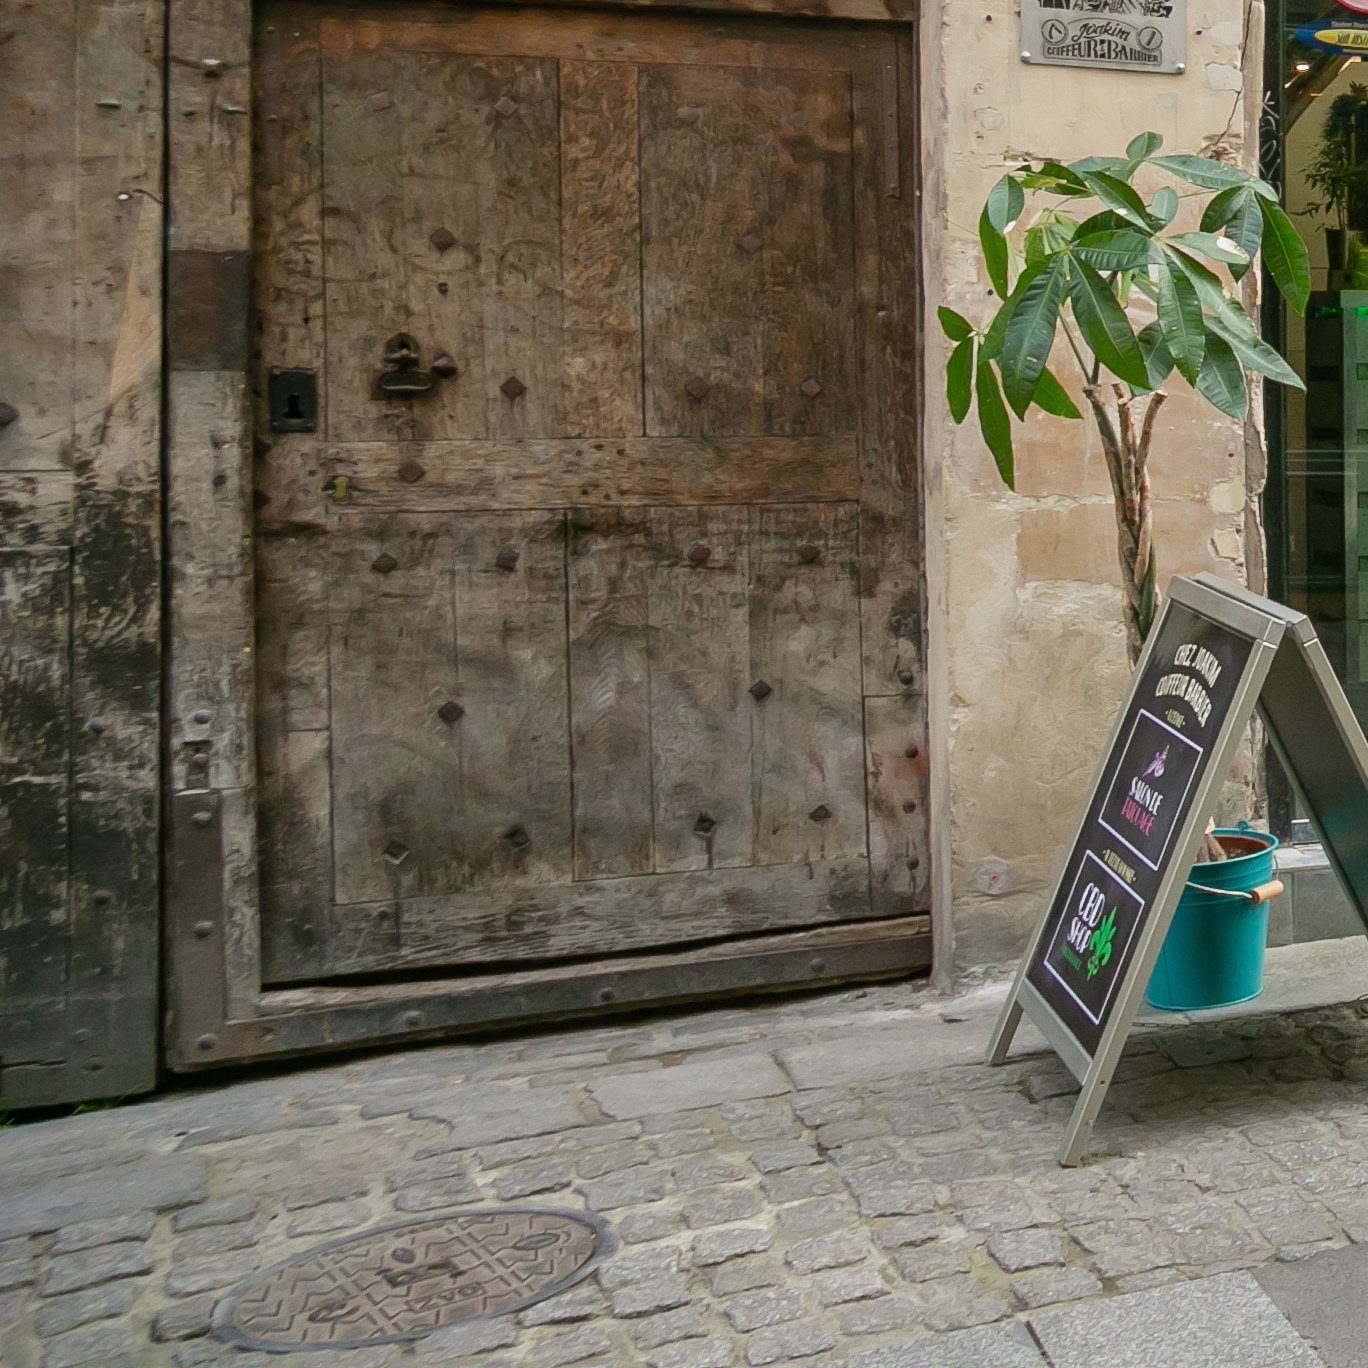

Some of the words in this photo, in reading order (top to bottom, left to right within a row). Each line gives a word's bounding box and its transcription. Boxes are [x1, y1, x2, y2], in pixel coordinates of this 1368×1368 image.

[1072, 22, 1131, 42] Joakim
[1079, 882, 1106, 927] CBD
[1067, 917, 1092, 953] SHOP
